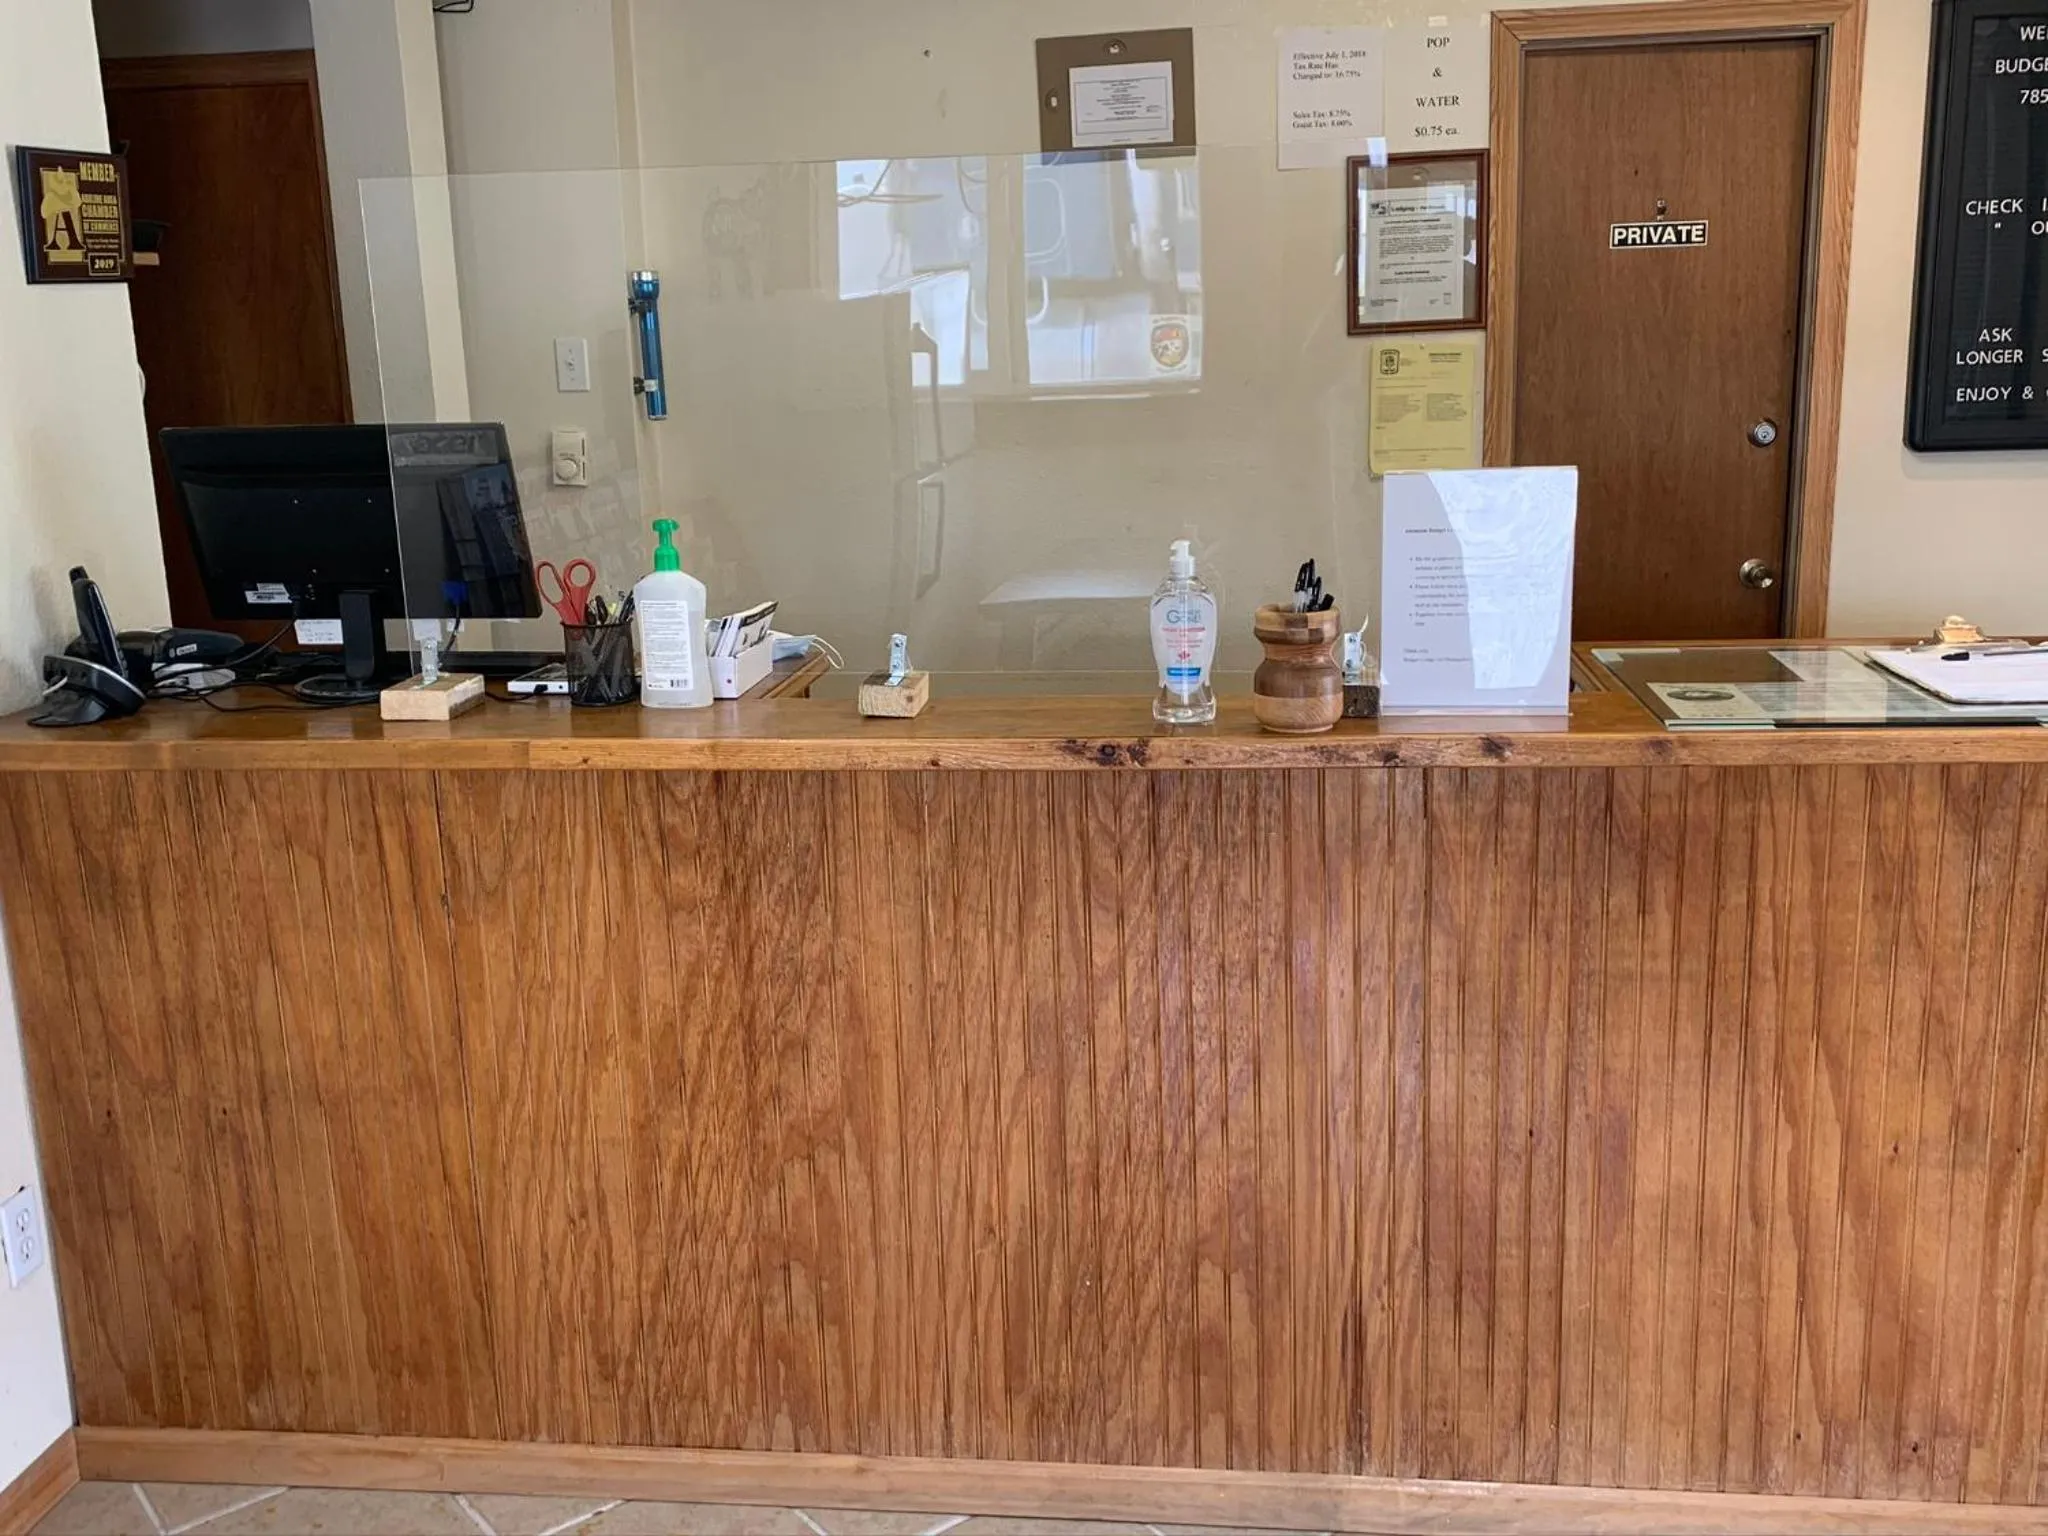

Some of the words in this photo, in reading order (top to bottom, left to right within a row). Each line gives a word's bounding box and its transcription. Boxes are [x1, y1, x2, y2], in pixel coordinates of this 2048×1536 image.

[2021, 25, 2048, 41] WE
[1426, 37, 1450, 48] POP
[1325, 51, 1339, 61] July
[1293, 62, 1306, 70] Tax
[1307, 62, 1323, 70] Rate
[1432, 67, 1442, 77] &
[1293, 71, 1323, 81] Changed
[1415, 95, 1460, 107] WATER
[2020, 88, 2048, 105] 785
[1415, 126, 1443, 137] $0.75
[80, 161, 116, 182] MEMBER
[82, 204, 119, 219] CHAMBER
[1966, 198, 2023, 215] CHECK
[1613, 224, 1705, 245] PRIVATE
[94, 258, 115, 270] 2019
[1978, 327, 2013, 343] ASK
[1956, 348, 2023, 365] LONGER
[1956, 386, 2012, 402] ENJOY
[2022, 385, 2034, 400] &
